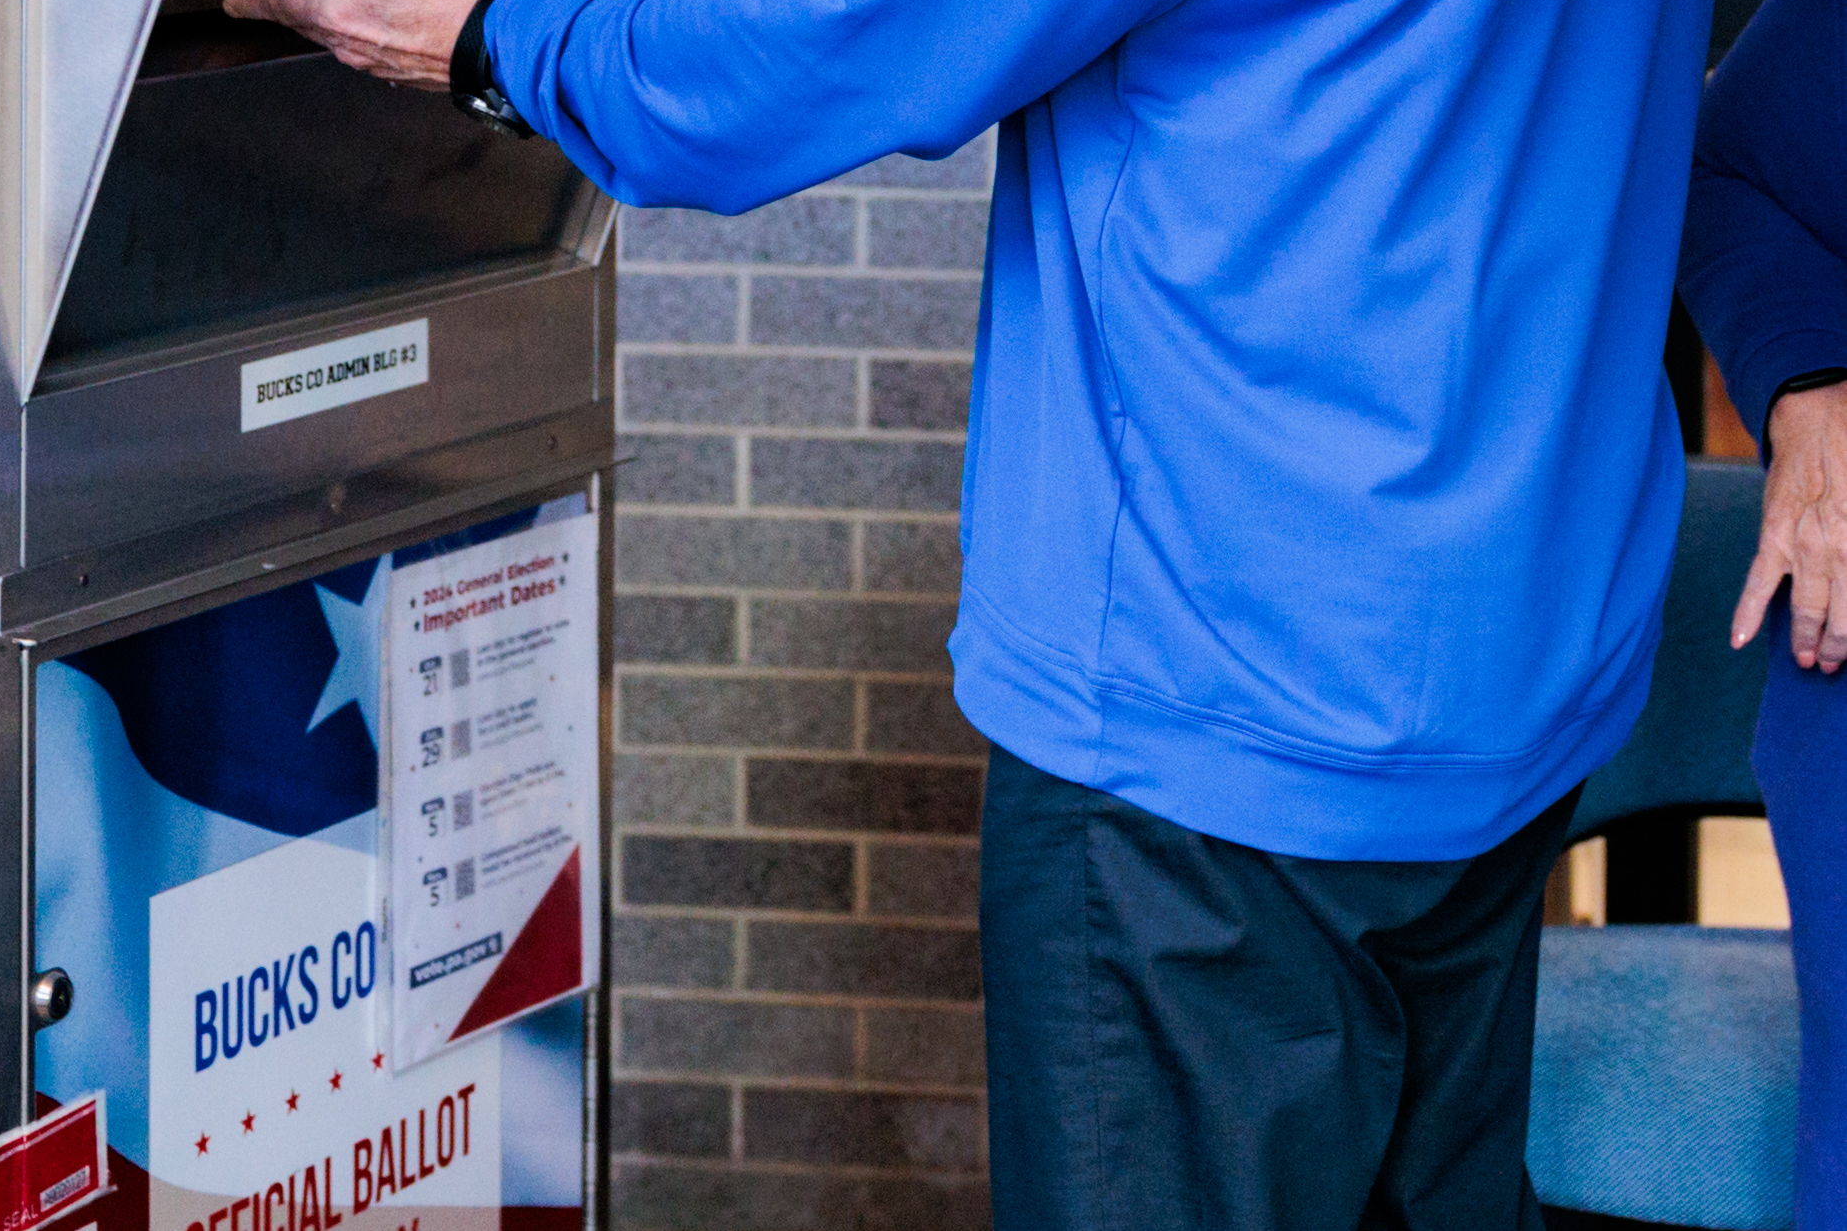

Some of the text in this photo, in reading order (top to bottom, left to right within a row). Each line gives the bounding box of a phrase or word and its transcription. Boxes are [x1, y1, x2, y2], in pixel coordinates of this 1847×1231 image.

[256, 342, 417, 404] BUCKS CO ADMIN BLG #3
[456, 568, 504, 596] General
[507, 554, 556, 581] Election
[423, 578, 556, 634] Important Dates
[428, 815, 439, 838] 5
[429, 885, 440, 908] 5
[194, 944, 319, 1074] BUCKS
[331, 920, 376, 1011] CO
[352, 1081, 477, 1216] BALLOT
